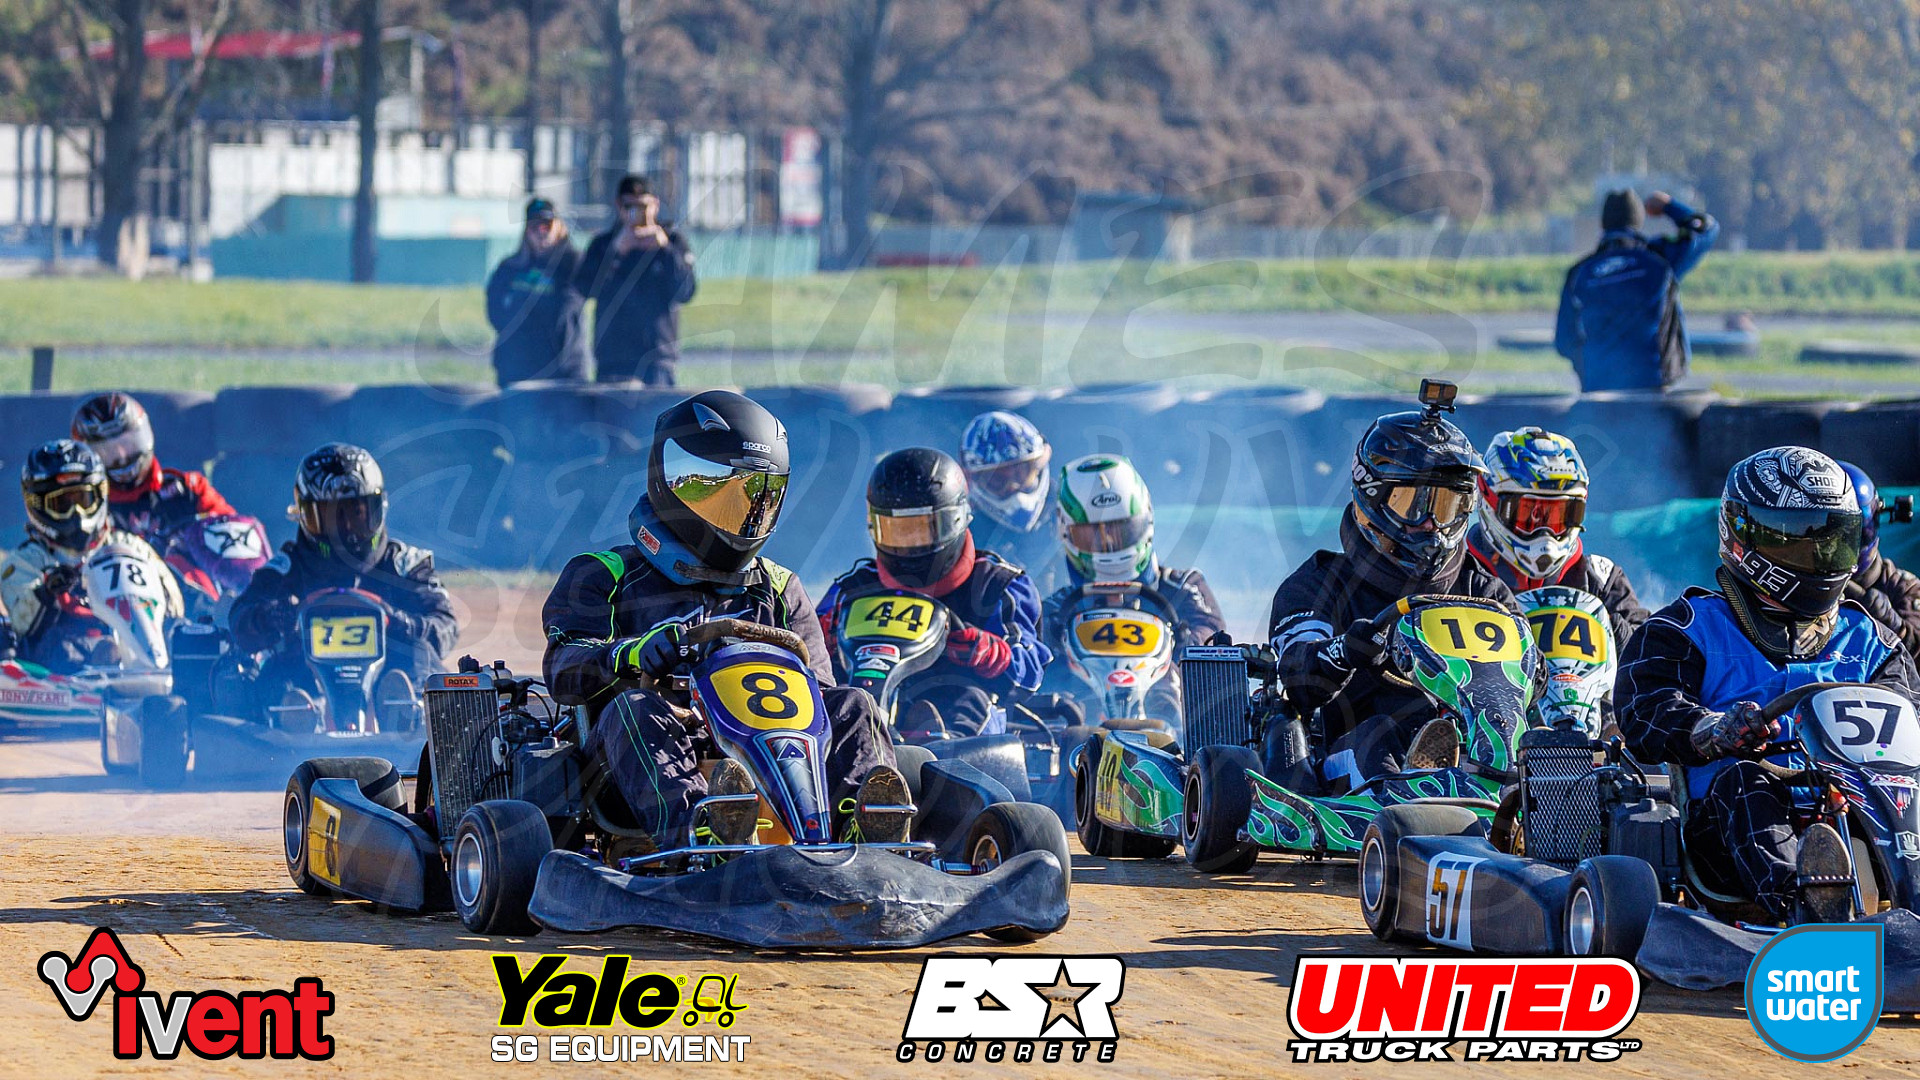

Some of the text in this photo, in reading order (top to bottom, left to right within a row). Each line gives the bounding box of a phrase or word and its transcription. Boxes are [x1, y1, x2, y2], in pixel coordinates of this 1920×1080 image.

[742, 441, 771, 453] sparco
[102, 563, 147, 591] 78
[864, 601, 924, 632] 44
[320, 624, 371, 646] 13
[1091, 622, 1146, 646] 43
[1440, 618, 1507, 652] 19
[1529, 613, 1597, 657] 74
[447, 678, 475, 686] ROTAX
[741, 672, 799, 719] 8
[1832, 700, 1903, 746] 57
[1428, 858, 1474, 941] 57
